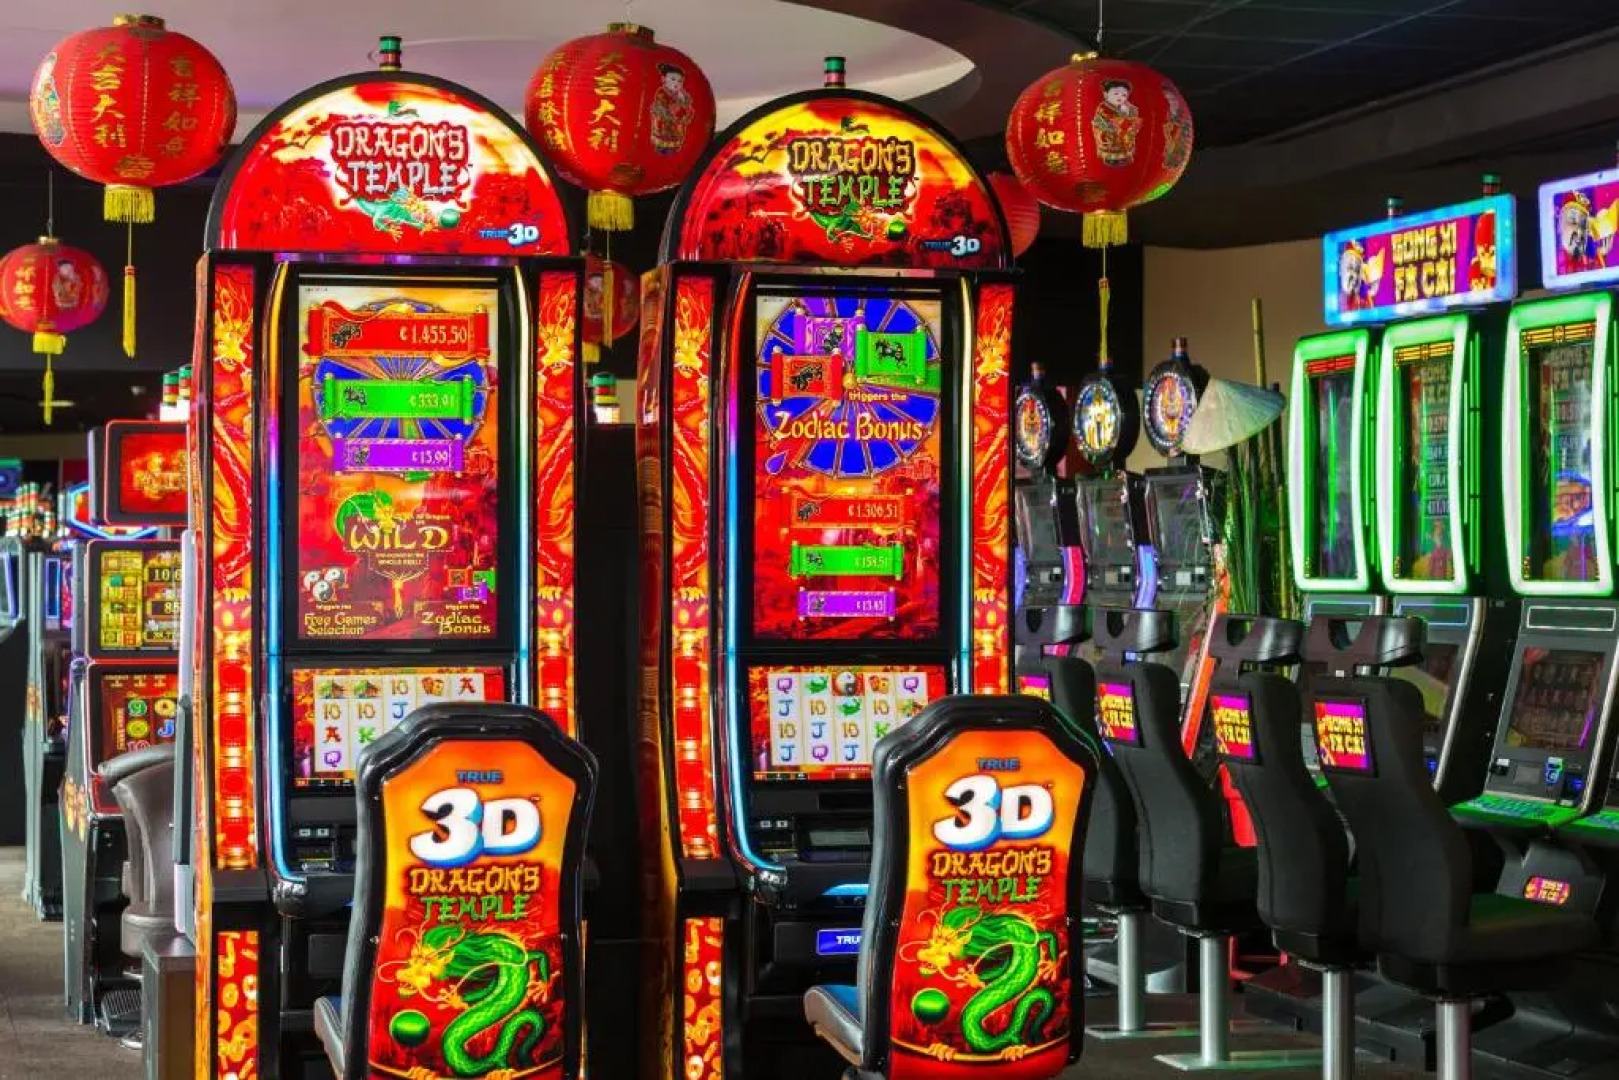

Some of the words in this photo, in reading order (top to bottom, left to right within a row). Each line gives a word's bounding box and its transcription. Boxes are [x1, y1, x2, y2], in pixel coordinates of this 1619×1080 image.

[335, 124, 465, 160] DRAGON'S
[791, 139, 912, 174] DRAGON'S
[347, 160, 458, 195] TEMPLE
[800, 175, 905, 207] TEMPLE
[508, 223, 540, 246] 3D
[950, 235, 980, 256] 3D
[774, 410, 850, 439] Zodiac
[856, 411, 923, 440] Bonus
[350, 524, 448, 550] WILD
[304, 613, 330, 625] Free
[335, 612, 377, 625] Games
[421, 612, 482, 624] Zodiac
[438, 622, 491, 635] Bonus
[777, 677, 793, 694] Q
[903, 676, 920, 693] Q
[323, 703, 342, 720] 10
[358, 703, 376, 720] 10
[392, 702, 408, 719] J
[778, 699, 793, 716] J
[810, 700, 827, 716] 10
[873, 700, 890, 715] 10
[323, 726, 342, 743] A
[778, 723, 796, 739] 10
[811, 722, 826, 738] J
[842, 722, 860, 738] 10
[324, 750, 342, 767] Q
[781, 745, 795, 761] J
[812, 745, 828, 761] Q
[845, 745, 859, 761] J
[977, 758, 1020, 771] TRUE
[456, 770, 503, 783] TRUE
[933, 774, 1054, 852] 3D
[410, 787, 542, 869] 3D
[932, 848, 1051, 877] DRAGON'S
[409, 864, 540, 894] DRAGON'S
[941, 876, 1042, 904] TEMPLE
[421, 894, 530, 922] TEMPLE
[836, 936, 862, 944] TRU
